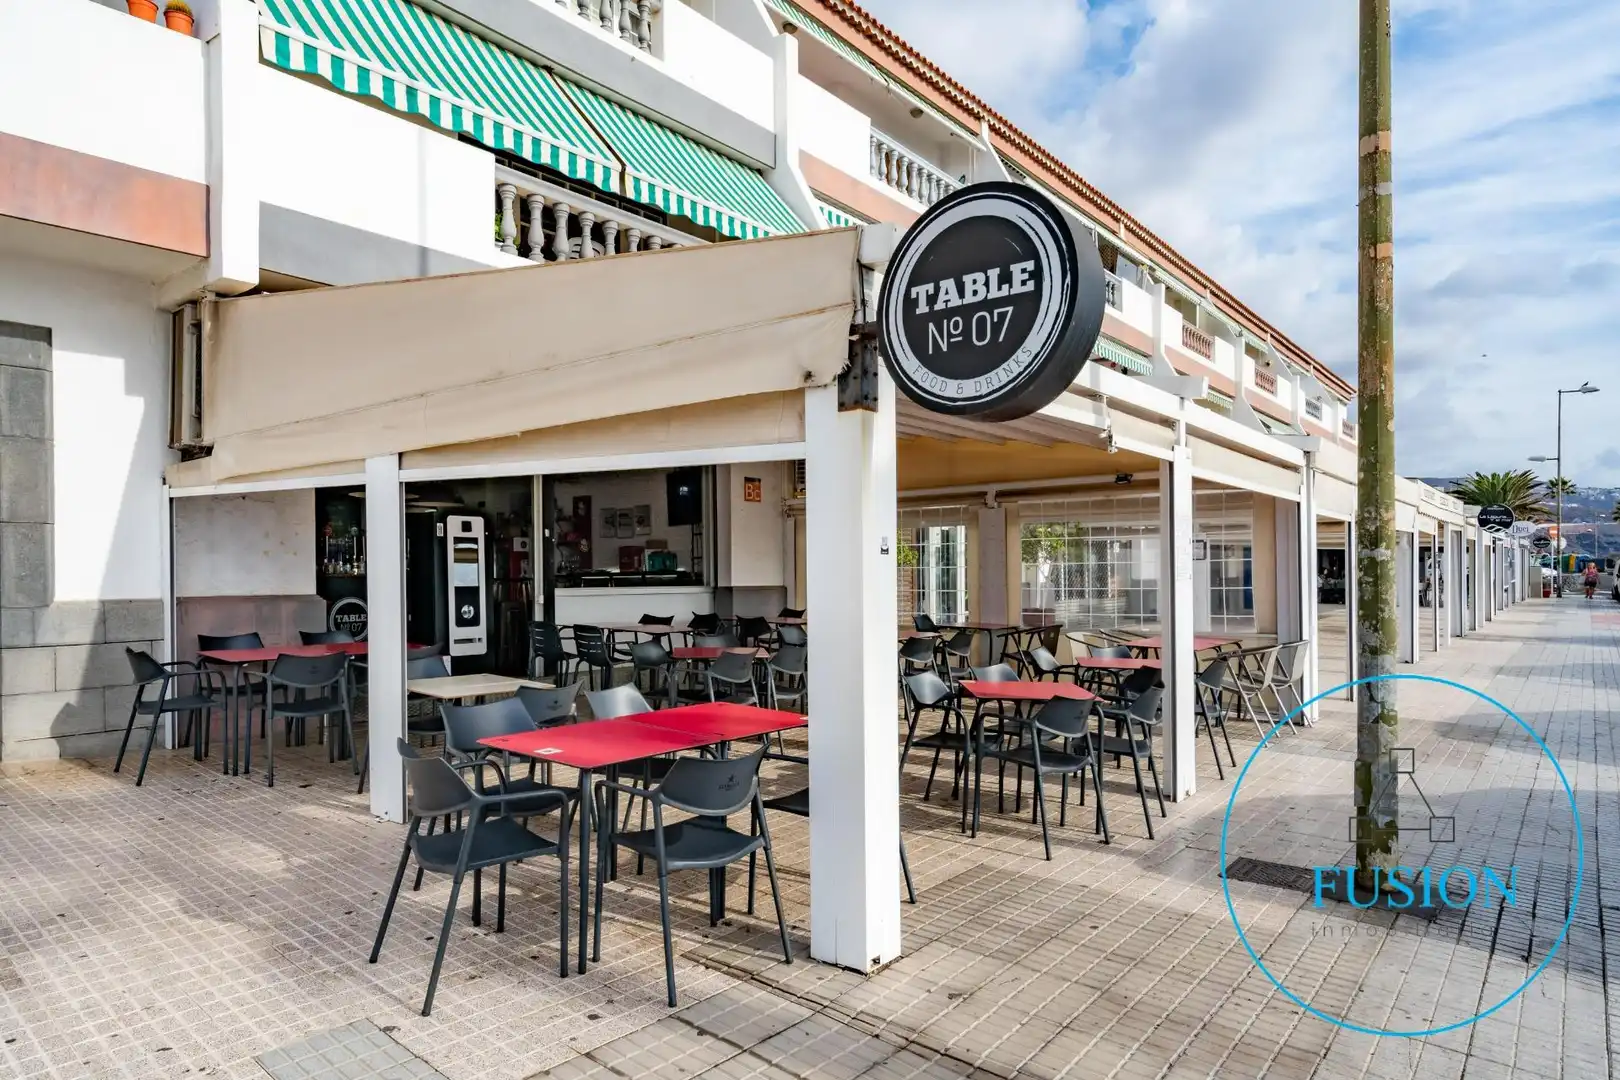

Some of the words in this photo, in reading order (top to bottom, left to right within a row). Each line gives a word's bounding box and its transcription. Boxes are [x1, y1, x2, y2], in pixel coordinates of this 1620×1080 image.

[911, 260, 1034, 314] TABLE
[972, 306, 1014, 346] 07
[913, 364, 948, 392] FOOD
[956, 380, 964, 394] &
[974, 346, 1033, 393] DRINKS
[335, 614, 367, 622] TABLE
[351, 623, 362, 632] 07
